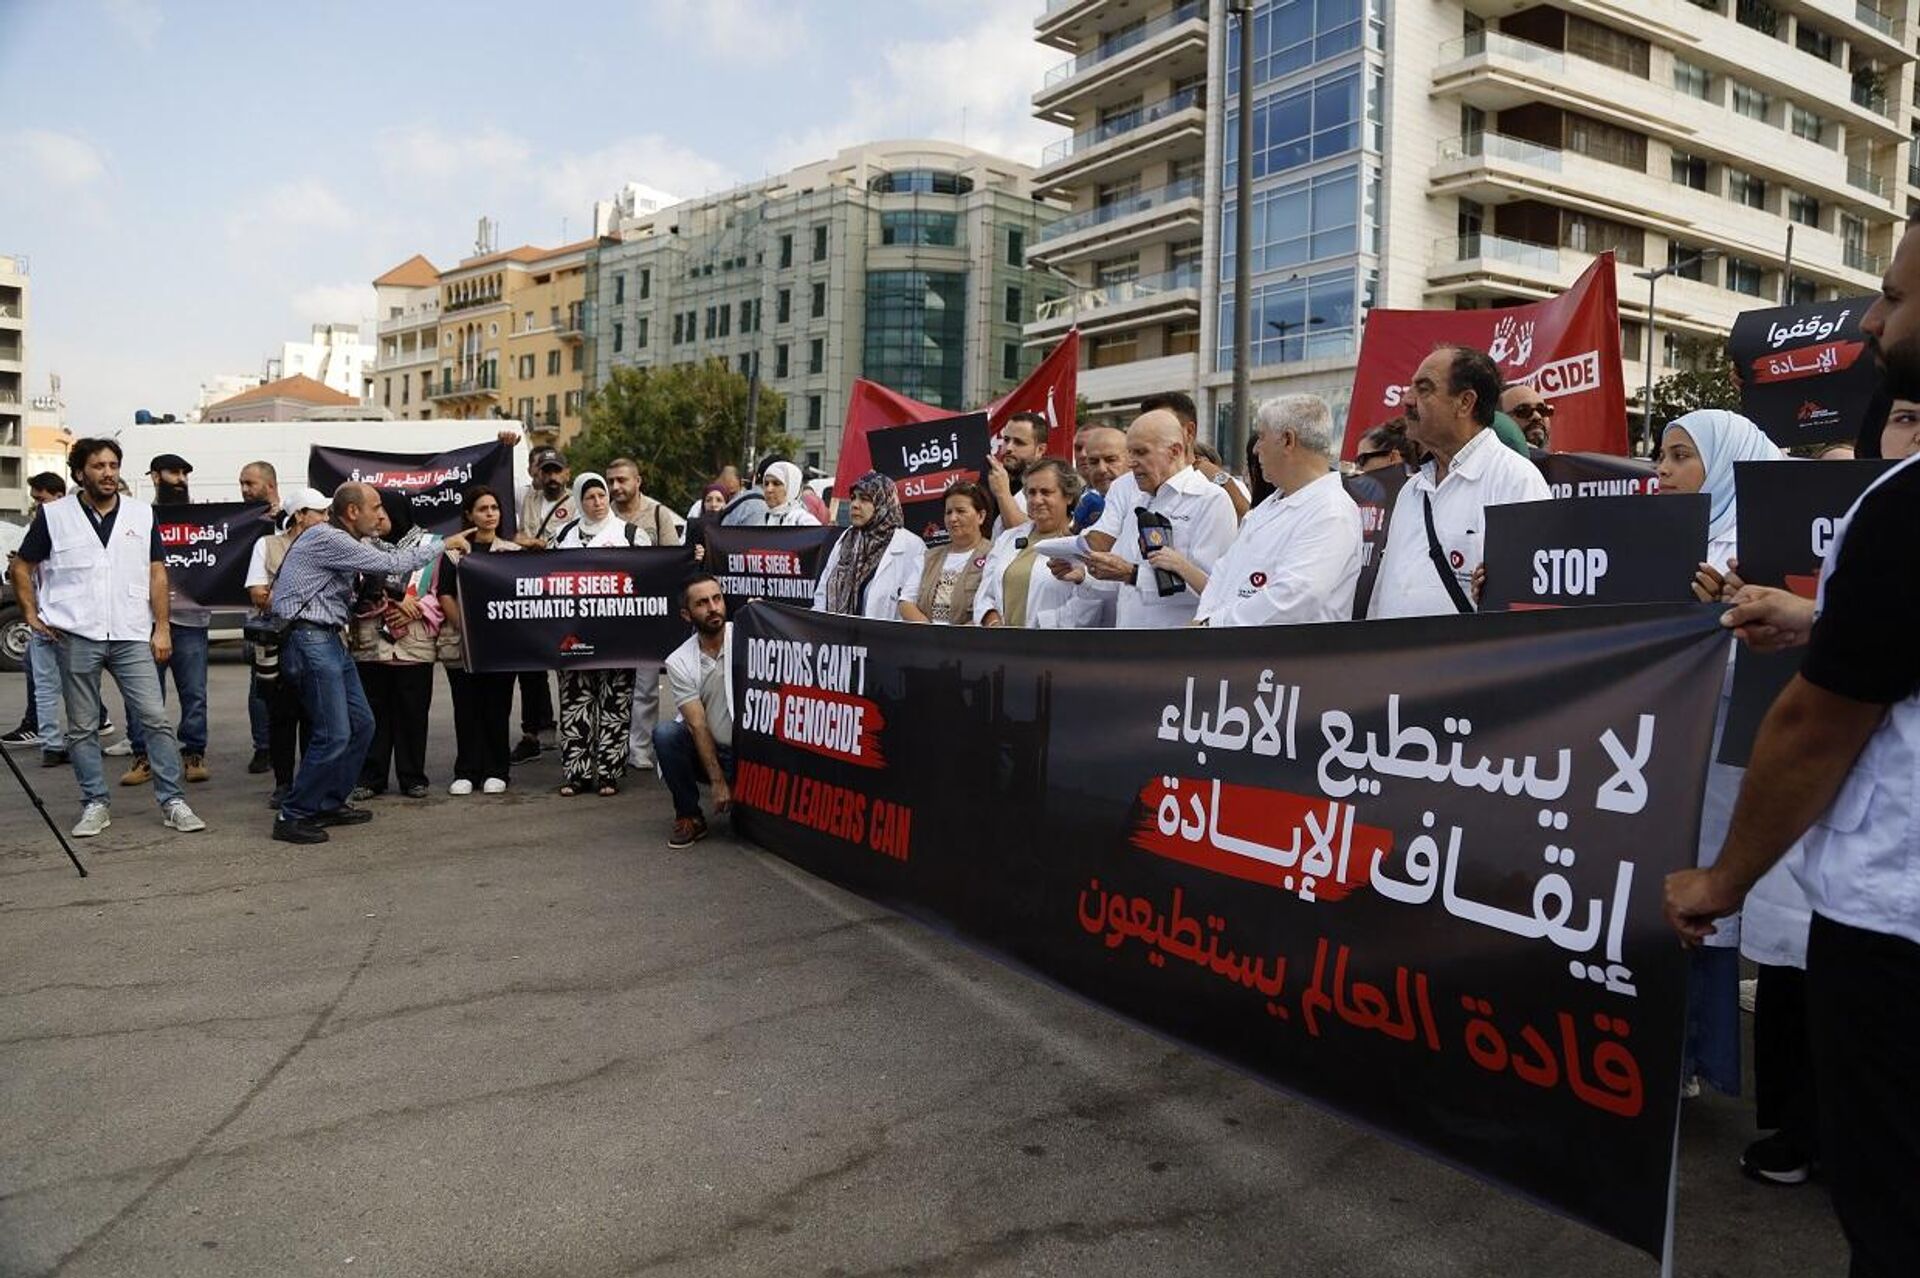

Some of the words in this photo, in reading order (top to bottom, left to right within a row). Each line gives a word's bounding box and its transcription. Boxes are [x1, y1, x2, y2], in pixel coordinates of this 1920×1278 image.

[1767, 309, 1851, 348] أوقفوا
[347, 468, 384, 484] العرق
[433, 463, 473, 484] أوقفوا
[901, 433, 959, 472] أوقفوا
[164, 548, 217, 568] والتهجي
[188, 523, 228, 545] أوقفوا
[516, 578, 544, 597] END
[548, 577, 574, 596] THE
[578, 574, 619, 595] SIEGE
[623, 576, 634, 594] &
[720, 576, 765, 596] STEMATIC
[728, 554, 745, 573] END
[746, 554, 763, 574] THE
[765, 555, 791, 575] SIEGE
[793, 557, 801, 575] &
[1532, 548, 1608, 596] STOP
[487, 599, 575, 620] SYSTEMATIC
[579, 597, 668, 619] STARVATION
[748, 637, 814, 689] DOCTORS
[817, 643, 868, 695] CAN'T
[742, 687, 780, 736] STOP
[783, 694, 865, 756] GENOCIDE
[1157, 669, 1300, 765] الأطباء
[1317, 694, 1571, 830] يستطيع
[1596, 714, 1655, 815] لا
[787, 774, 868, 845] LEADERS
[869, 800, 912, 862] CAN
[1370, 811, 1637, 998] إيقاف
[1078, 877, 1290, 1021] يستطيعون
[1302, 936, 1441, 1051] العالم
[1461, 995, 1643, 1117] قادة
